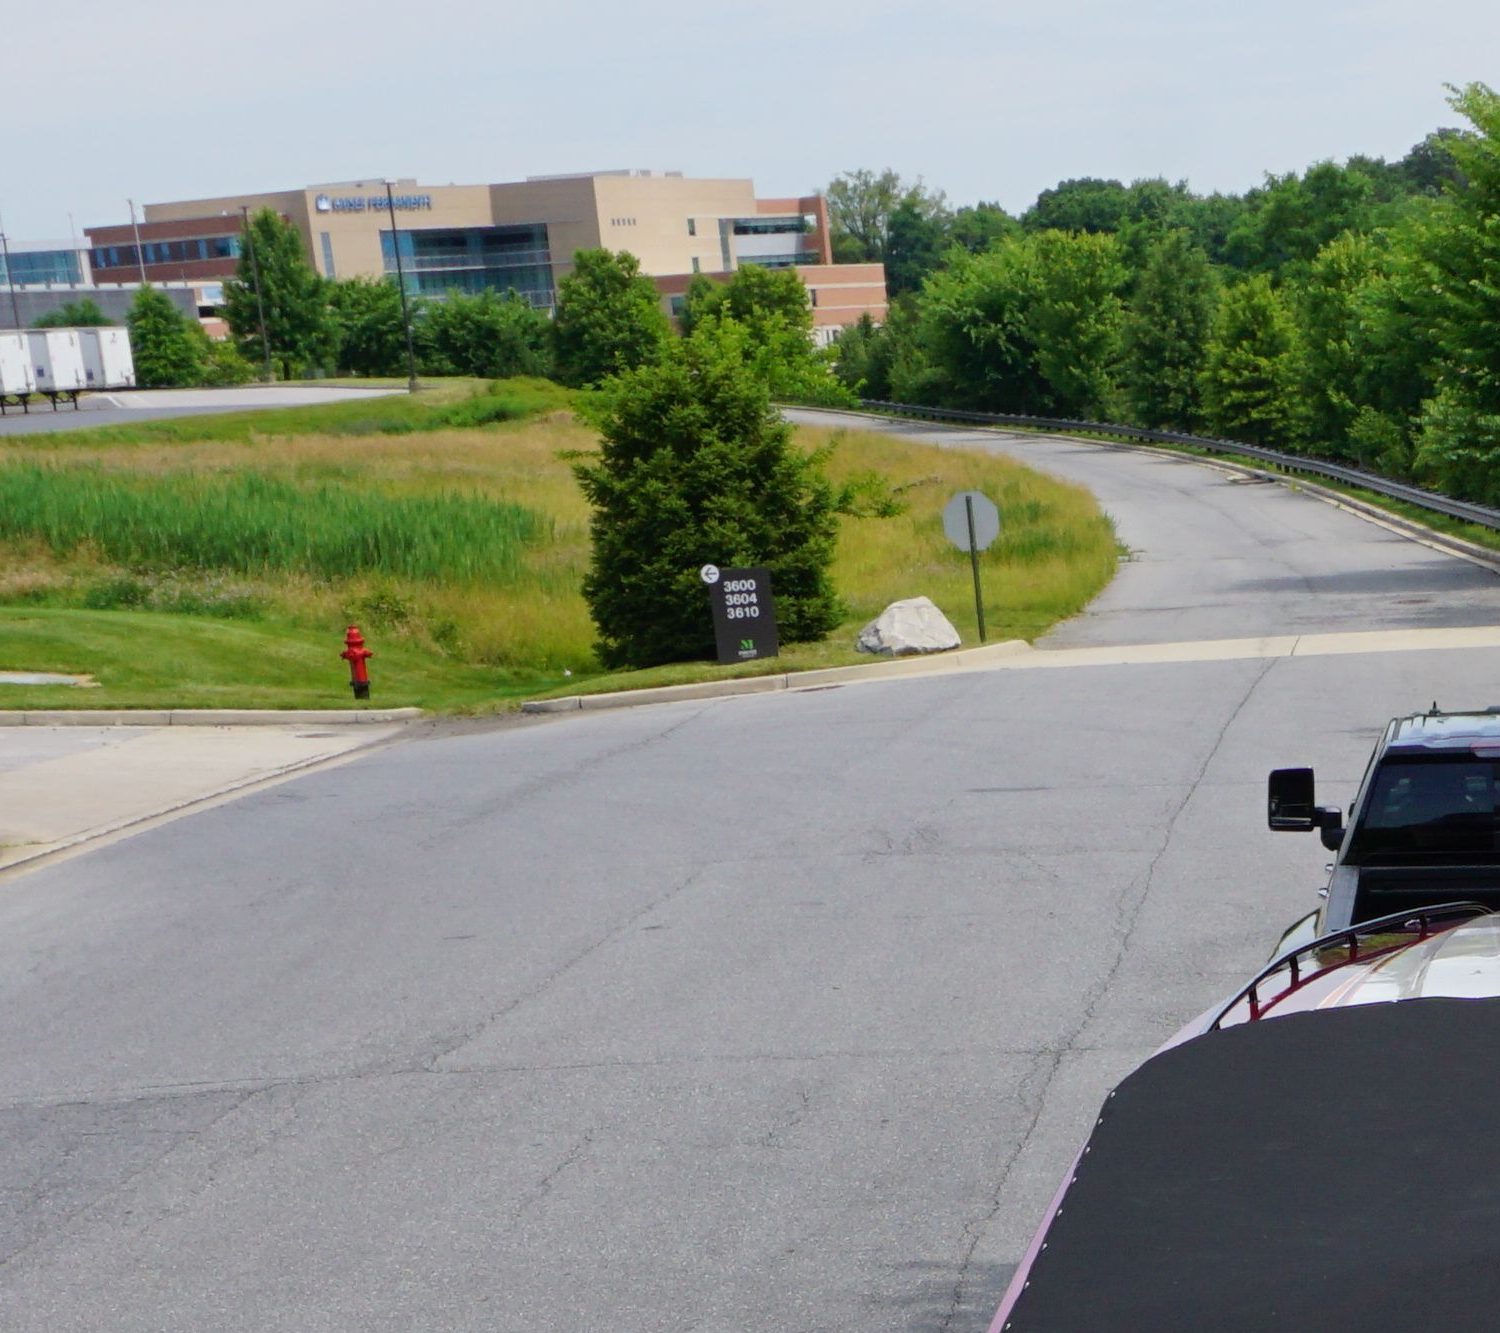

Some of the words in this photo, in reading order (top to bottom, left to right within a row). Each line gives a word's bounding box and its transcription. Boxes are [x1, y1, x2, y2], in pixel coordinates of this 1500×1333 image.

[723, 578, 756, 592] 3600
[725, 593, 757, 605] 3604
[727, 606, 759, 619] 3610
